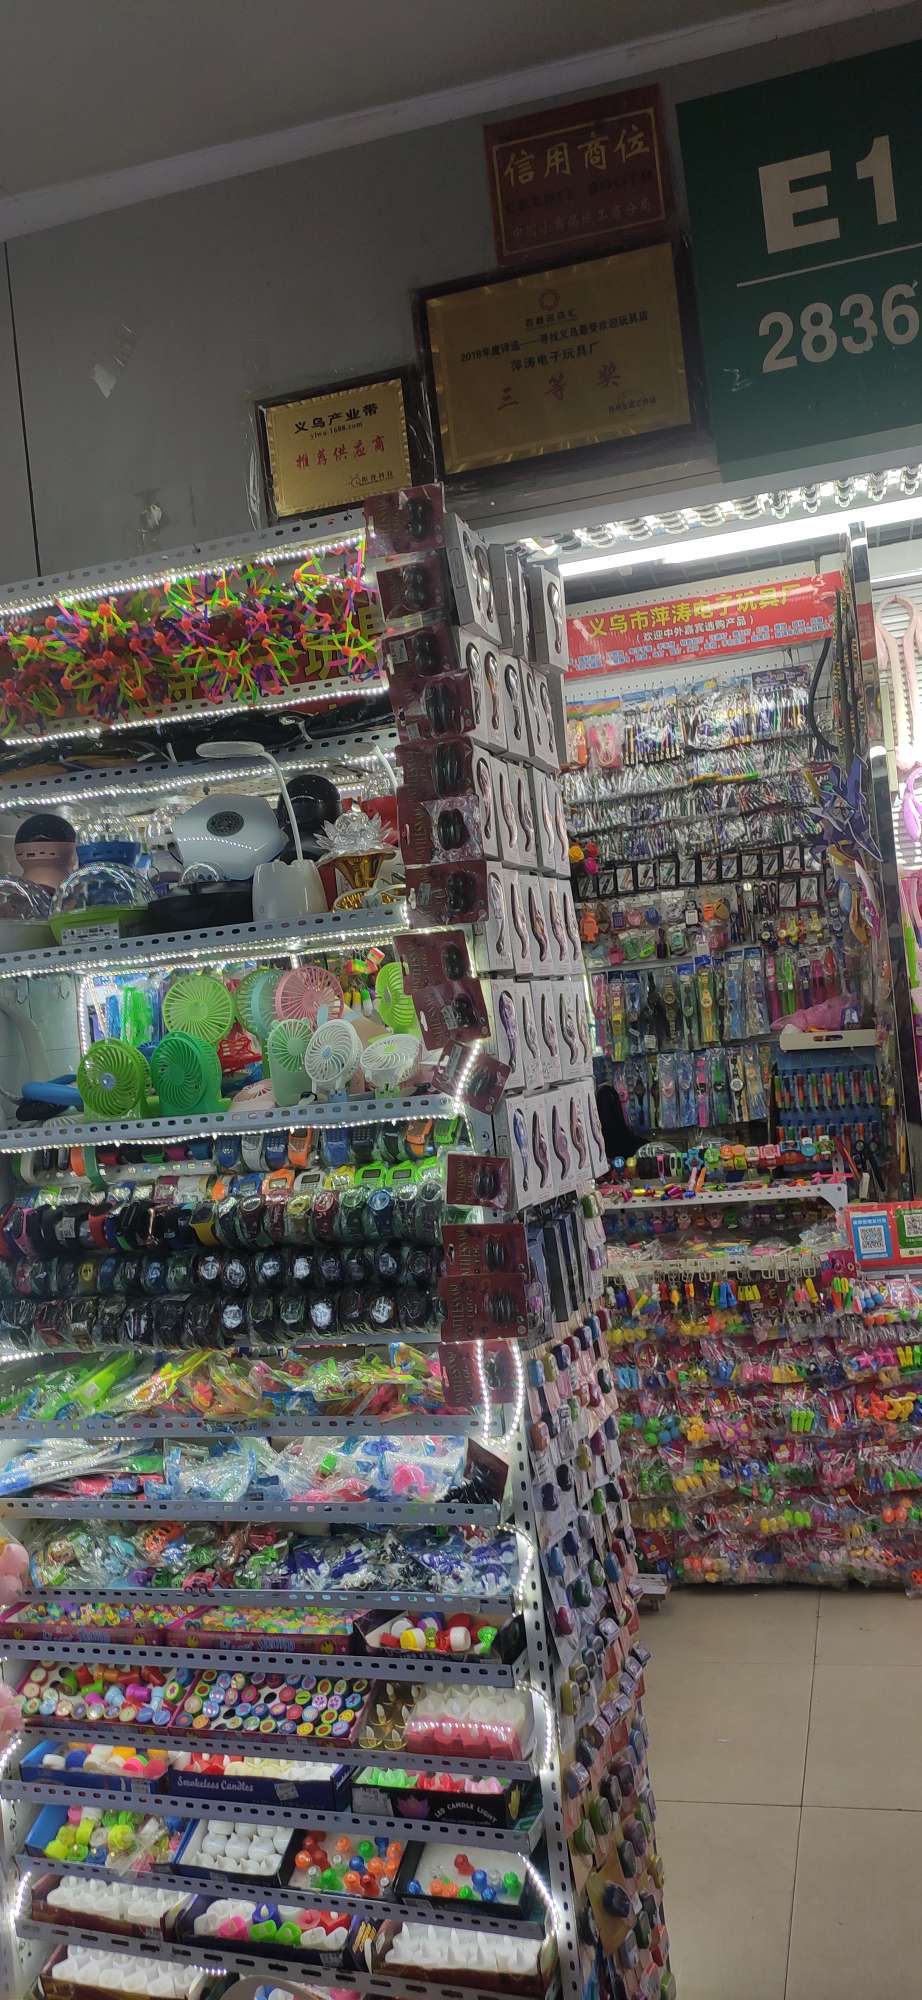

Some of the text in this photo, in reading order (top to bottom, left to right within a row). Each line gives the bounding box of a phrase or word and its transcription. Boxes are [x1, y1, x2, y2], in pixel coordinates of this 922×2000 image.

[503, 123, 650, 187] 信用商位
[758, 134, 898, 254] E1
[758, 283, 921, 373] 2836
[511, 341, 600, 373] 萍涛电子玩具厂
[294, 403, 379, 434] 义乌产业带
[296, 434, 386, 470] 推荐供应商
[588, 583, 801, 639] 义乌市萍涛电子玩具厂
[177, 1775, 254, 1793] Smokeless Candles
[447, 1801, 474, 1810] CANDLE
[476, 1807, 499, 1824] LIGHT
